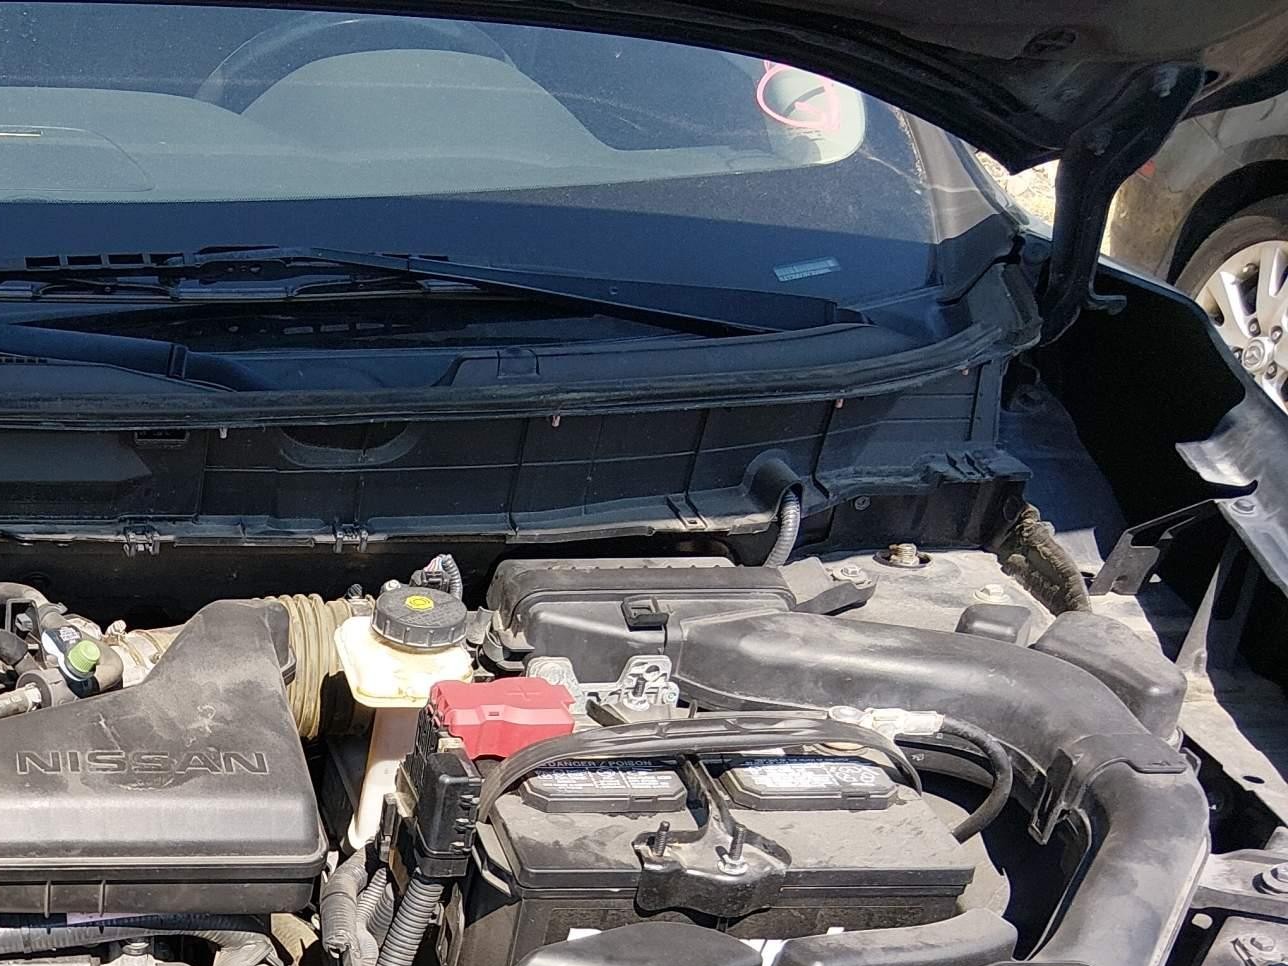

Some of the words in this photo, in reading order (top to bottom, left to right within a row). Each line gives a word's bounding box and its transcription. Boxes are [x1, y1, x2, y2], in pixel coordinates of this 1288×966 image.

[15, 749, 269, 775] NISSAN
[548, 759, 597, 767] DANGER
[609, 759, 652, 767] POISON
